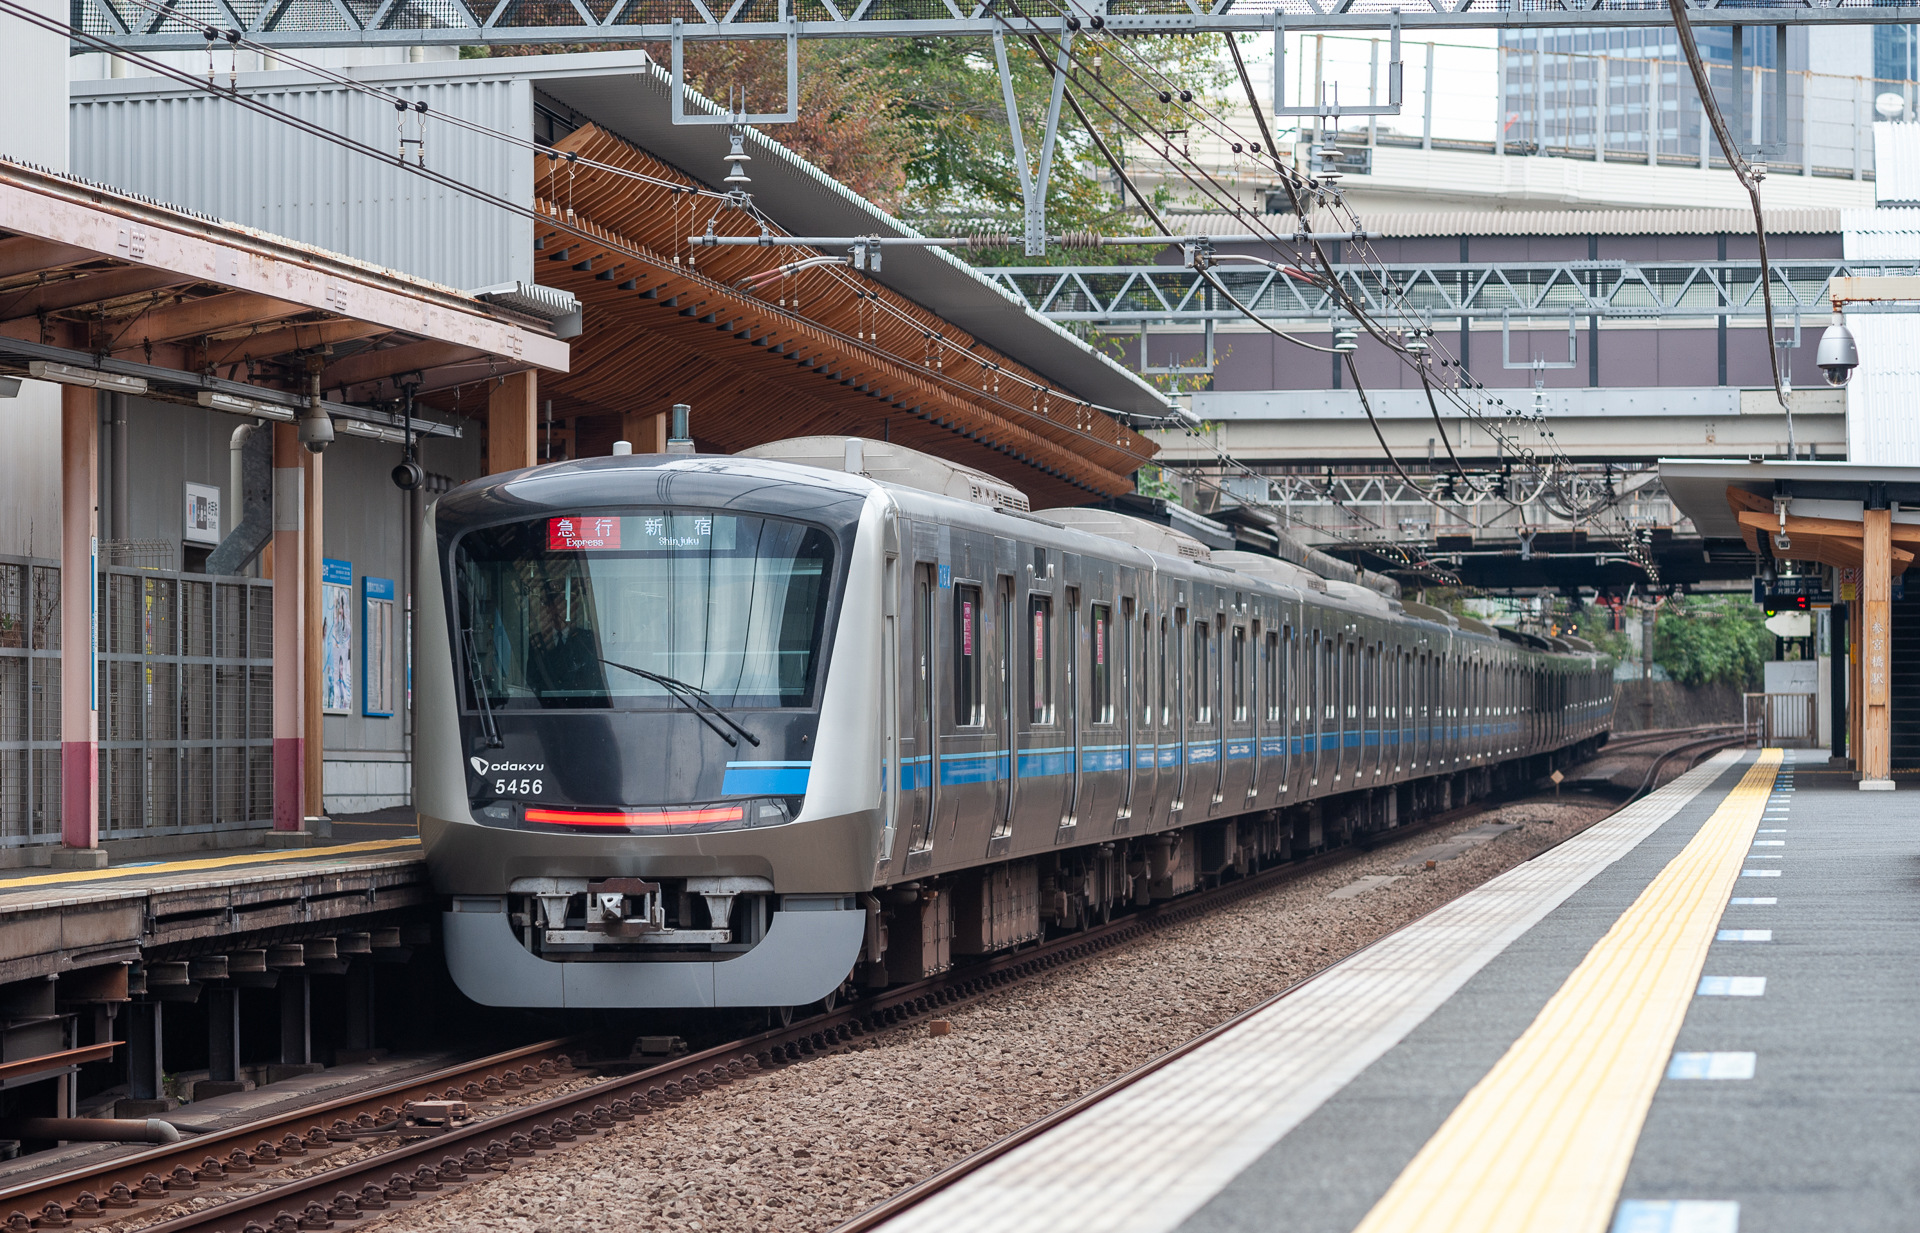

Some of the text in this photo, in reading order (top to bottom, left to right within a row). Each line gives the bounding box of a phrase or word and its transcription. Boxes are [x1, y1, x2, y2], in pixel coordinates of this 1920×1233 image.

[556, 518, 614, 538] 急行
[644, 517, 712, 536] 新宿
[566, 538, 604, 548] Express
[658, 536, 700, 547] Shinjuku
[490, 760, 545, 771] odakyu
[495, 779, 543, 795] 5456
